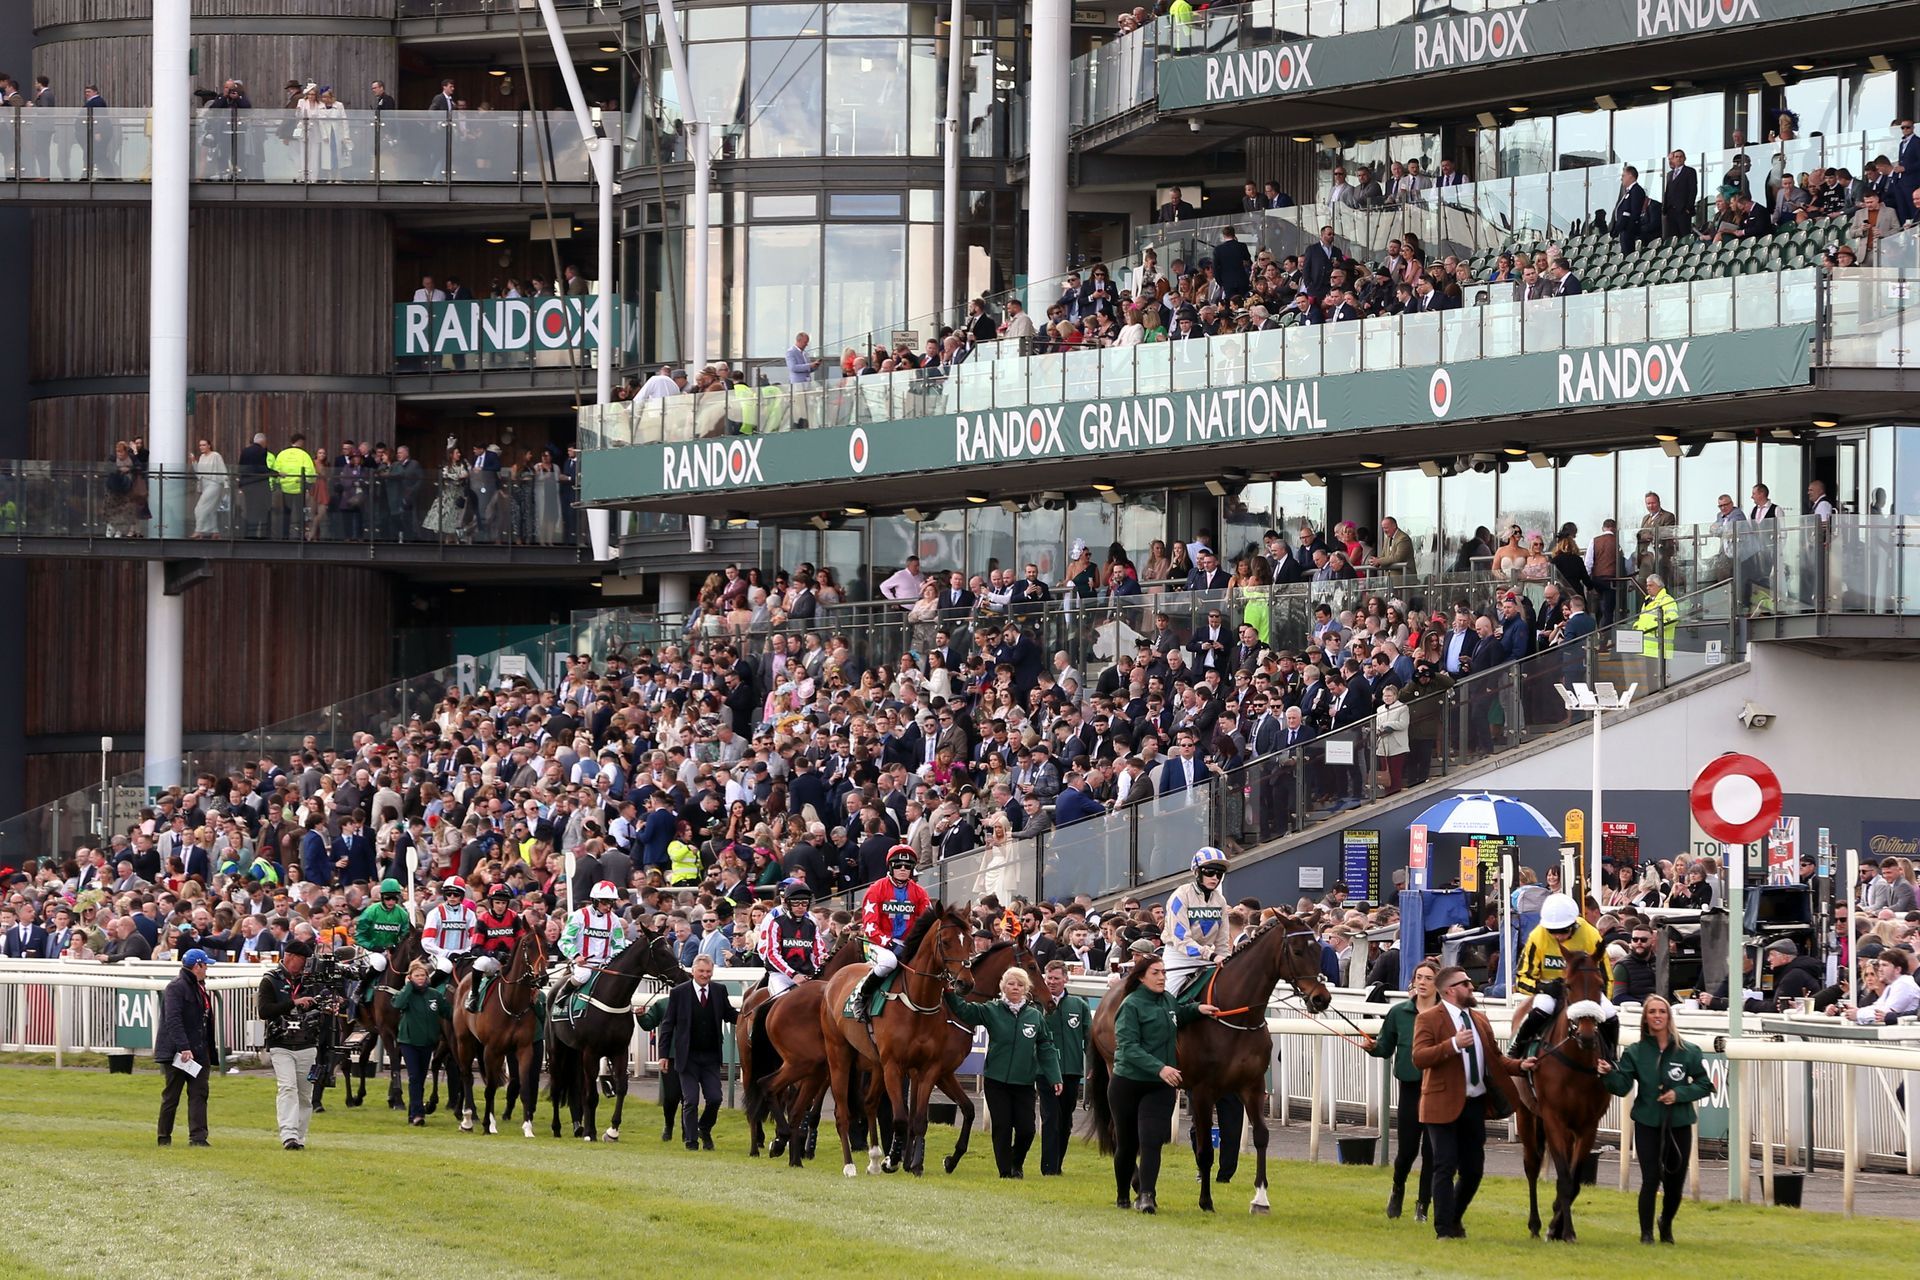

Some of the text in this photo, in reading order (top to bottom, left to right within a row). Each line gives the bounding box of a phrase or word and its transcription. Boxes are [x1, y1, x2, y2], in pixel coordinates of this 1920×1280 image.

[1414, 8, 1528, 70] RANDOX
[1206, 43, 1314, 100] RANDOX
[406, 298, 600, 353] RANDOX
[1558, 341, 1691, 404] RANDOX
[956, 381, 1328, 463] RANDOX GRAND NATIONAL
[663, 438, 764, 490] RANDOX
[1870, 835, 1918, 854] William
[882, 903, 916, 913] RANDOX
[1188, 909, 1222, 918] RANDOX
[374, 923, 400, 932] RANDOX
[442, 922, 467, 930] RANDOX
[487, 928, 514, 936] RANDOX
[584, 928, 610, 938] RANDOX
[783, 939, 813, 948] RANDOX
